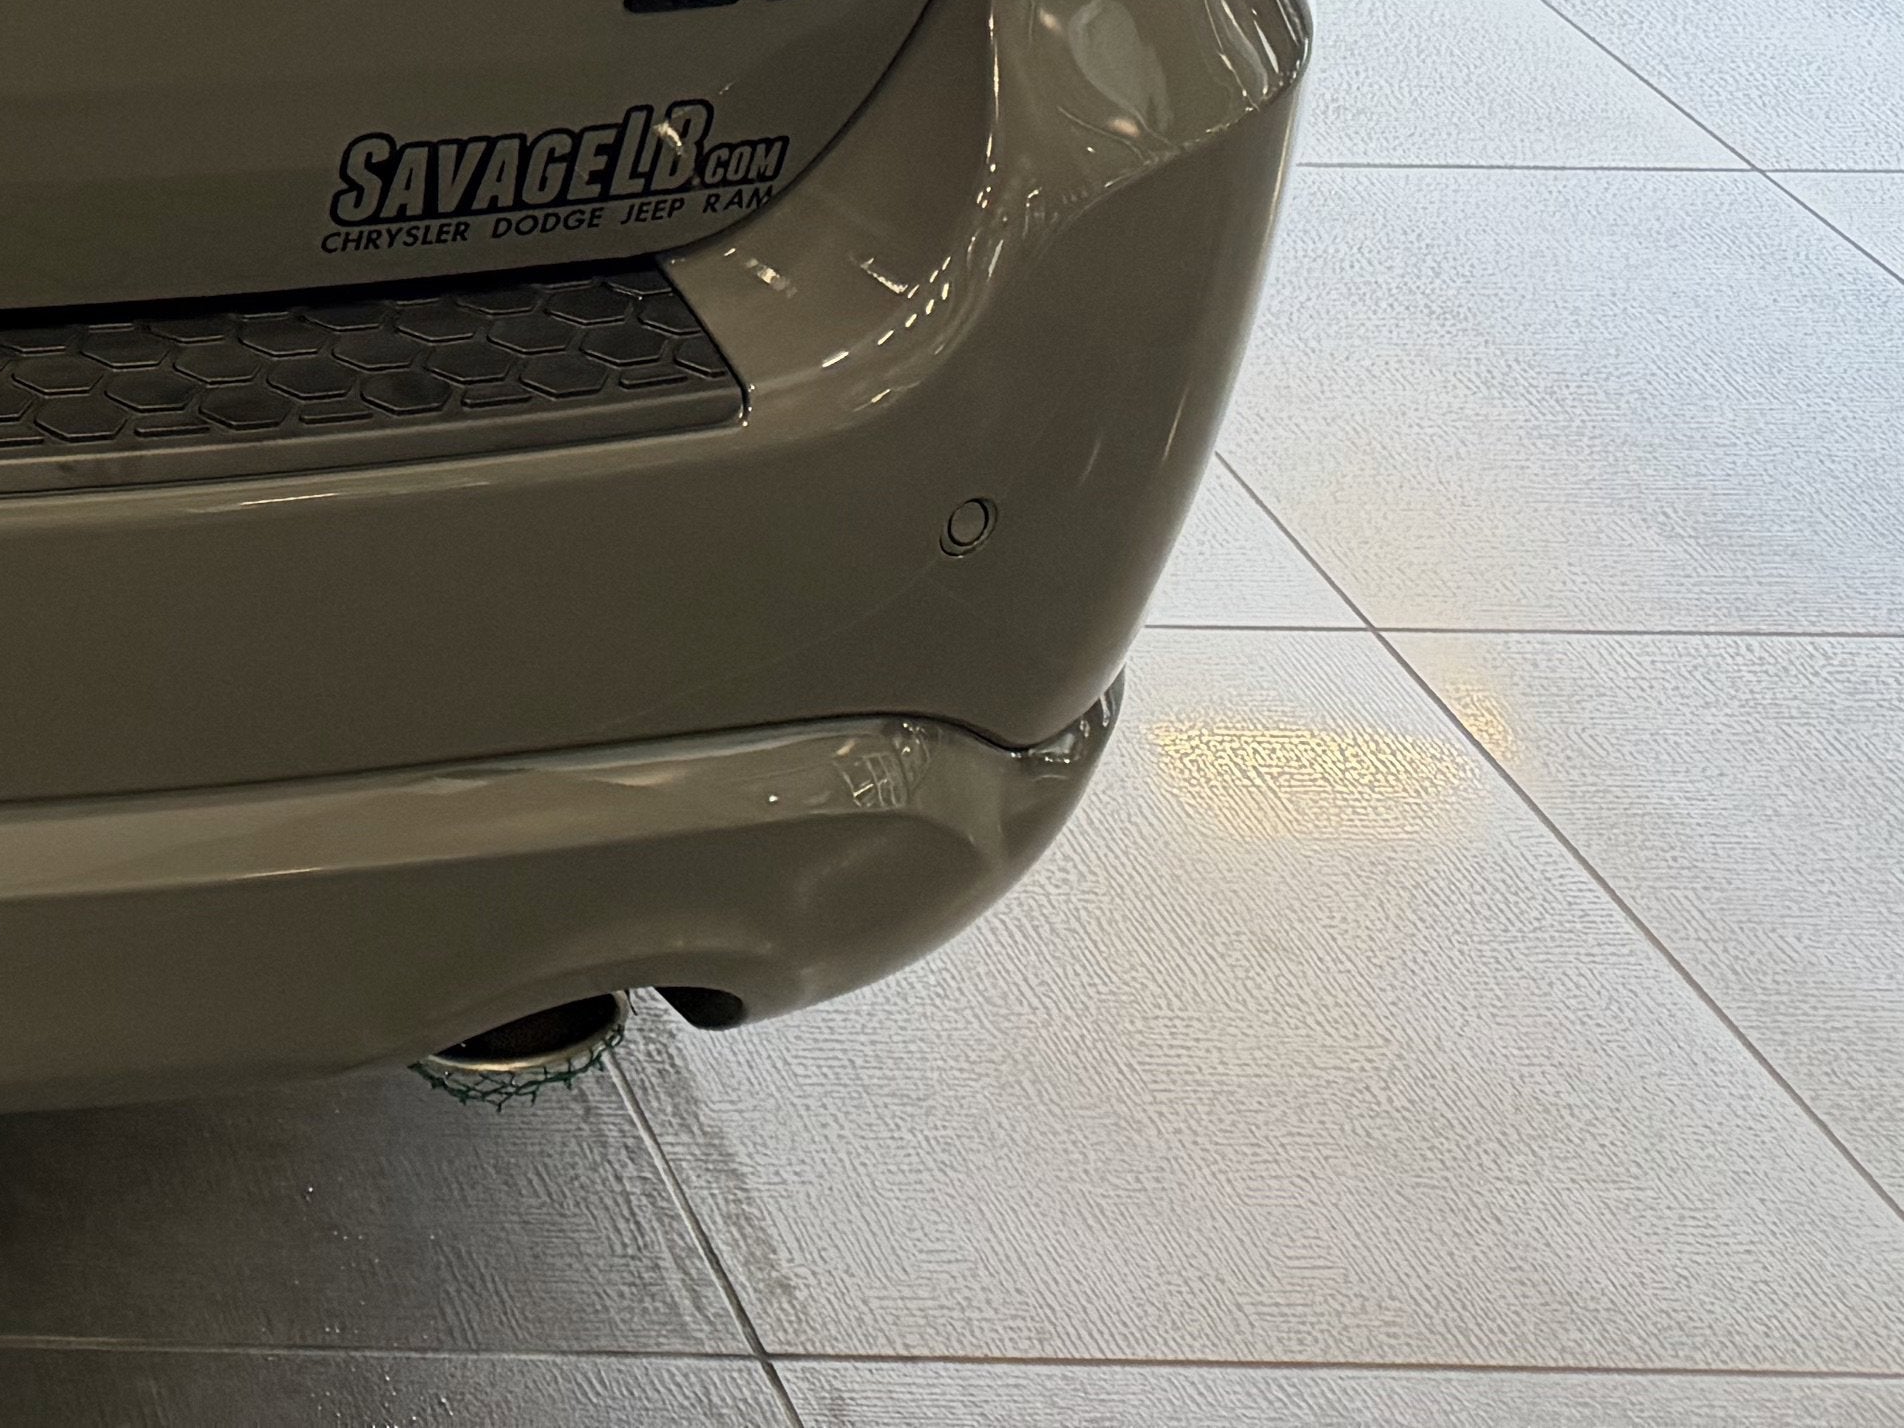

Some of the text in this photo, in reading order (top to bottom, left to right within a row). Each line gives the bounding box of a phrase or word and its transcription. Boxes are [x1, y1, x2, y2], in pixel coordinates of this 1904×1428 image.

[321, 184, 774, 254] CHRYSLER DODGE JEEP RAM
